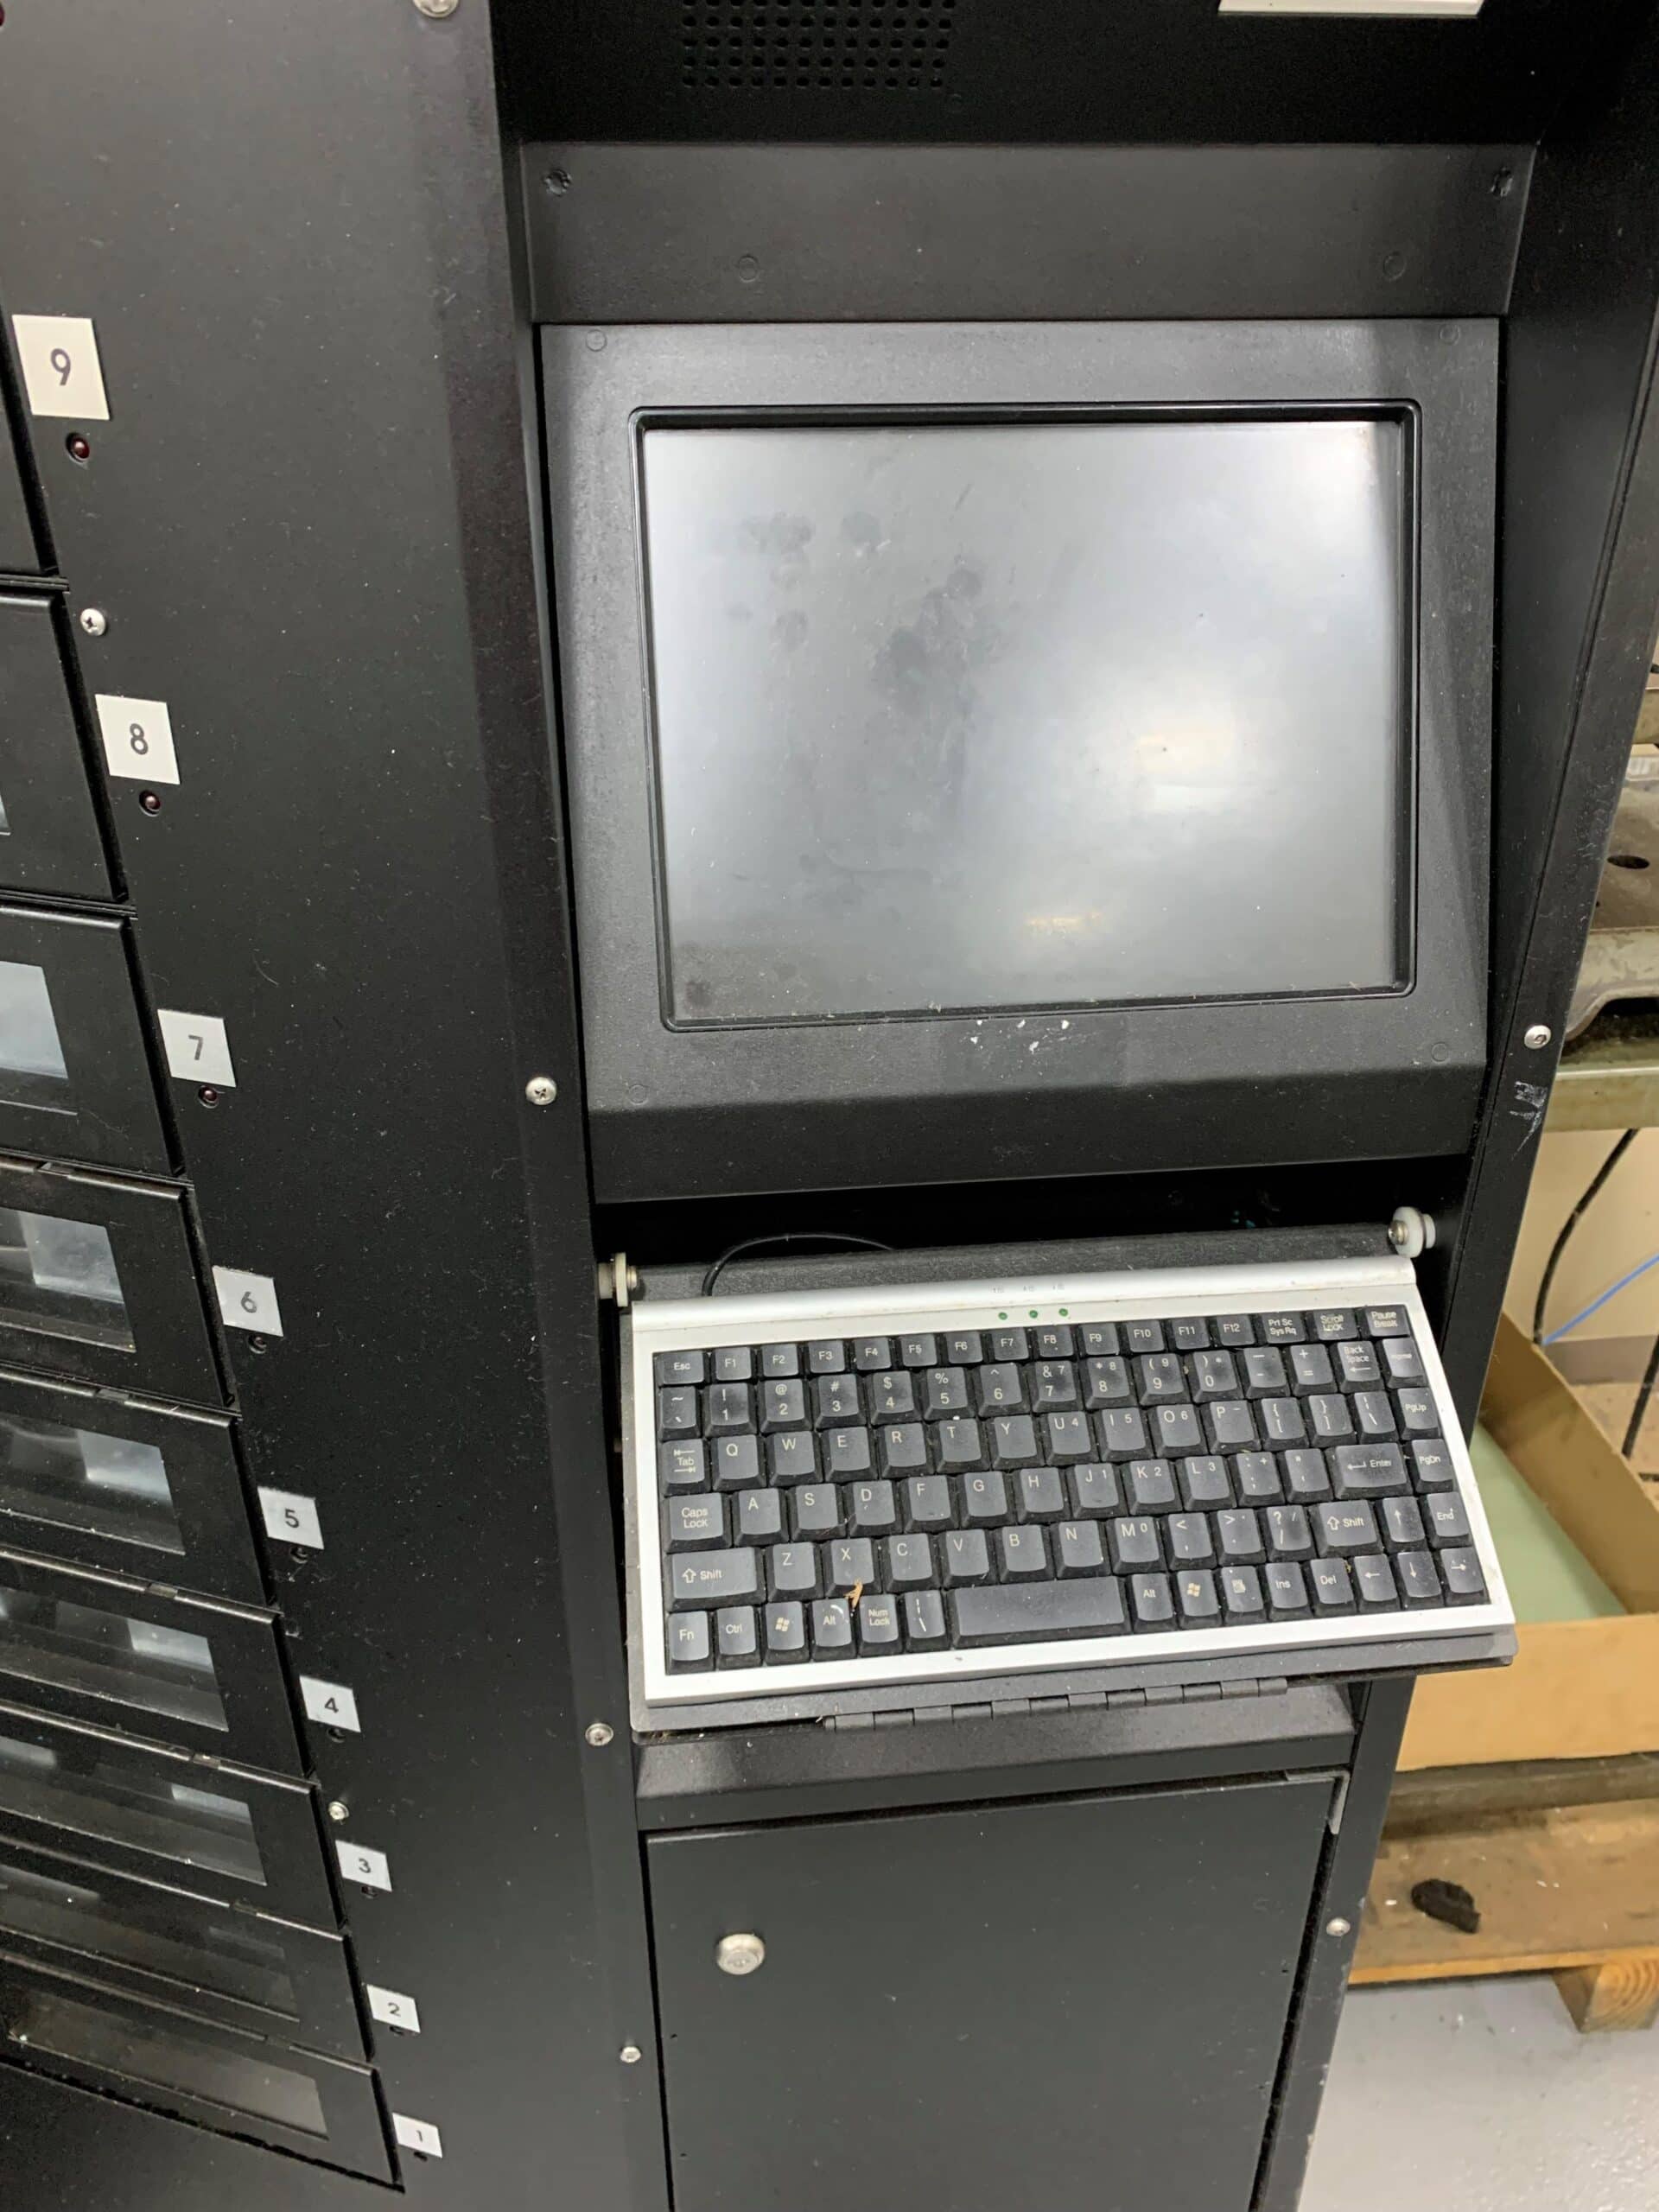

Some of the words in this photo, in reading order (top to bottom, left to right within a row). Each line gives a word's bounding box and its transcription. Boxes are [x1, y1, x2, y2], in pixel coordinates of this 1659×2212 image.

[50, 348, 72, 386] 9
[130, 723, 149, 755] 8
[188, 1034, 204, 1061] 7
[240, 1291, 257, 1314] 6
[1223, 1323, 1240, 1333] F12
[1268, 1319, 1281, 1327] Prt
[1133, 1329, 1152, 1338] F10
[1179, 1326, 1196, 1336] F11
[1269, 1327, 1284, 1336] Sys
[1001, 1338, 1014, 1347] F7
[1043, 1335, 1057, 1344] F8
[1089, 1333, 1103, 1343] F9
[865, 1347, 879, 1357] F4
[908, 1344, 922, 1354] F5
[955, 1341, 968, 1351] F6
[772, 1355, 785, 1364] F2
[818, 1351, 833, 1360] F3
[673, 1362, 691, 1370] Esc
[724, 1358, 736, 1368] F1
[1109, 1361, 1116, 1370] 8
[1161, 1357, 1169, 1367] 9
[1042, 1365, 1052, 1378] &
[1058, 1365, 1065, 1375] 7
[883, 1376, 893, 1389] $
[935, 1372, 949, 1384] %
[1153, 1377, 1162, 1389] 9
[1205, 1376, 1214, 1387] 0
[775, 1384, 788, 1395] @
[830, 1381, 840, 1392] #
[1046, 1385, 1054, 1397] 7
[1098, 1380, 1108, 1392] 8
[940, 1392, 950, 1404] 5
[994, 1388, 1002, 1400] 6
[832, 1400, 841, 1411] 3
[886, 1396, 895, 1408] 4
[779, 1403, 788, 1415] 2
[1216, 1406, 1225, 1419] P
[1405, 1403, 1427, 1414] PgUp
[722, 1409, 728, 1421] 1
[1125, 1414, 1133, 1423] 5
[1180, 1410, 1188, 1421] 6
[1001, 1423, 1010, 1435] Y
[1054, 1418, 1065, 1430] U
[1071, 1418, 1079, 1427] 4
[892, 1431, 902, 1444] R
[947, 1427, 957, 1439] T
[782, 1437, 796, 1451] W
[837, 1435, 847, 1447] E
[726, 1444, 739, 1457] Q
[677, 1456, 695, 1466] Tab
[1370, 1459, 1393, 1468] Enter
[1419, 1455, 1441, 1465] PgDn
[1136, 1466, 1148, 1478] K
[1154, 1466, 1162, 1477] 2
[1192, 1462, 1201, 1474] L
[1208, 1462, 1216, 1471] 3
[1028, 1475, 1039, 1488] H
[1084, 1471, 1093, 1483] J
[917, 1483, 925, 1496] F
[973, 1479, 985, 1492] G
[804, 1492, 816, 1506] S
[861, 1488, 872, 1501] D
[747, 1497, 759, 1510] A
[284, 1508, 300, 1529] 5
[681, 1507, 709, 1519] Caps
[1274, 1510, 1282, 1524] ?
[1437, 1512, 1455, 1522] End
[683, 1518, 709, 1529] Lock
[1343, 1517, 1365, 1529] Shift
[1065, 1527, 1077, 1541] N
[1122, 1523, 1135, 1537] M
[953, 1538, 963, 1551] V
[1009, 1534, 1020, 1547] B
[841, 1548, 851, 1560] X
[897, 1542, 908, 1556] C
[782, 1553, 793, 1566] Z
[700, 1569, 722, 1580] Shift
[1320, 1575, 1337, 1585] Del
[1275, 1580, 1291, 1589] Ins
[1143, 1589, 1156, 1598] Alt
[868, 1608, 888, 1617] Num
[823, 1615, 836, 1625] Alt
[869, 1617, 890, 1626] Lock
[679, 1629, 695, 1641] Fn
[726, 1624, 743, 1634] Ctrl
[324, 1697, 340, 1713] 4
[359, 1858, 372, 1874] 3
[388, 2002, 401, 2017] 2
[416, 2130, 423, 2142] 1
